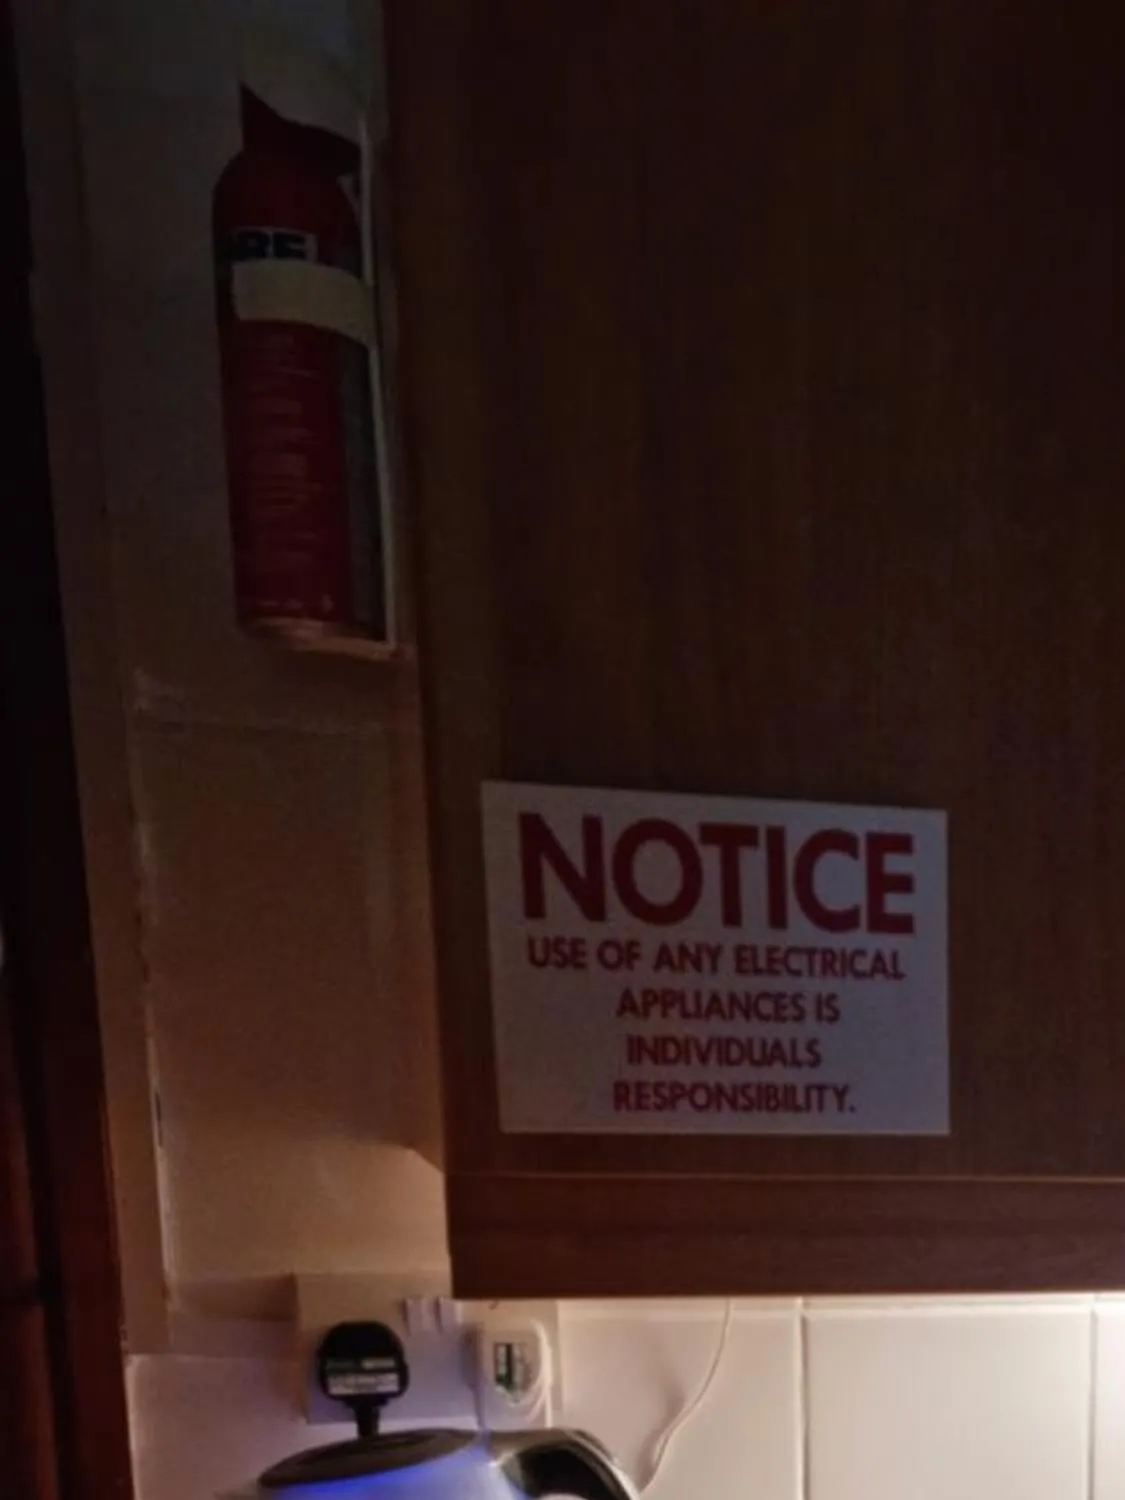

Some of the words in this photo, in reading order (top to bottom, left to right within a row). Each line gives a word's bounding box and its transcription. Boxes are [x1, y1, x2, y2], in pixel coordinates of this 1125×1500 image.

[518, 812, 915, 934] NOTICE
[527, 936, 587, 970] USE
[598, 940, 641, 971] OF
[654, 942, 724, 975] ANY
[735, 946, 906, 980] ELECTRICAL
[616, 988, 806, 1023] APPLIANCES
[816, 992, 841, 1024] IS
[626, 1034, 822, 1069] INDIVIDUALS
[613, 1081, 857, 1114] RESPONSIBILITY.
